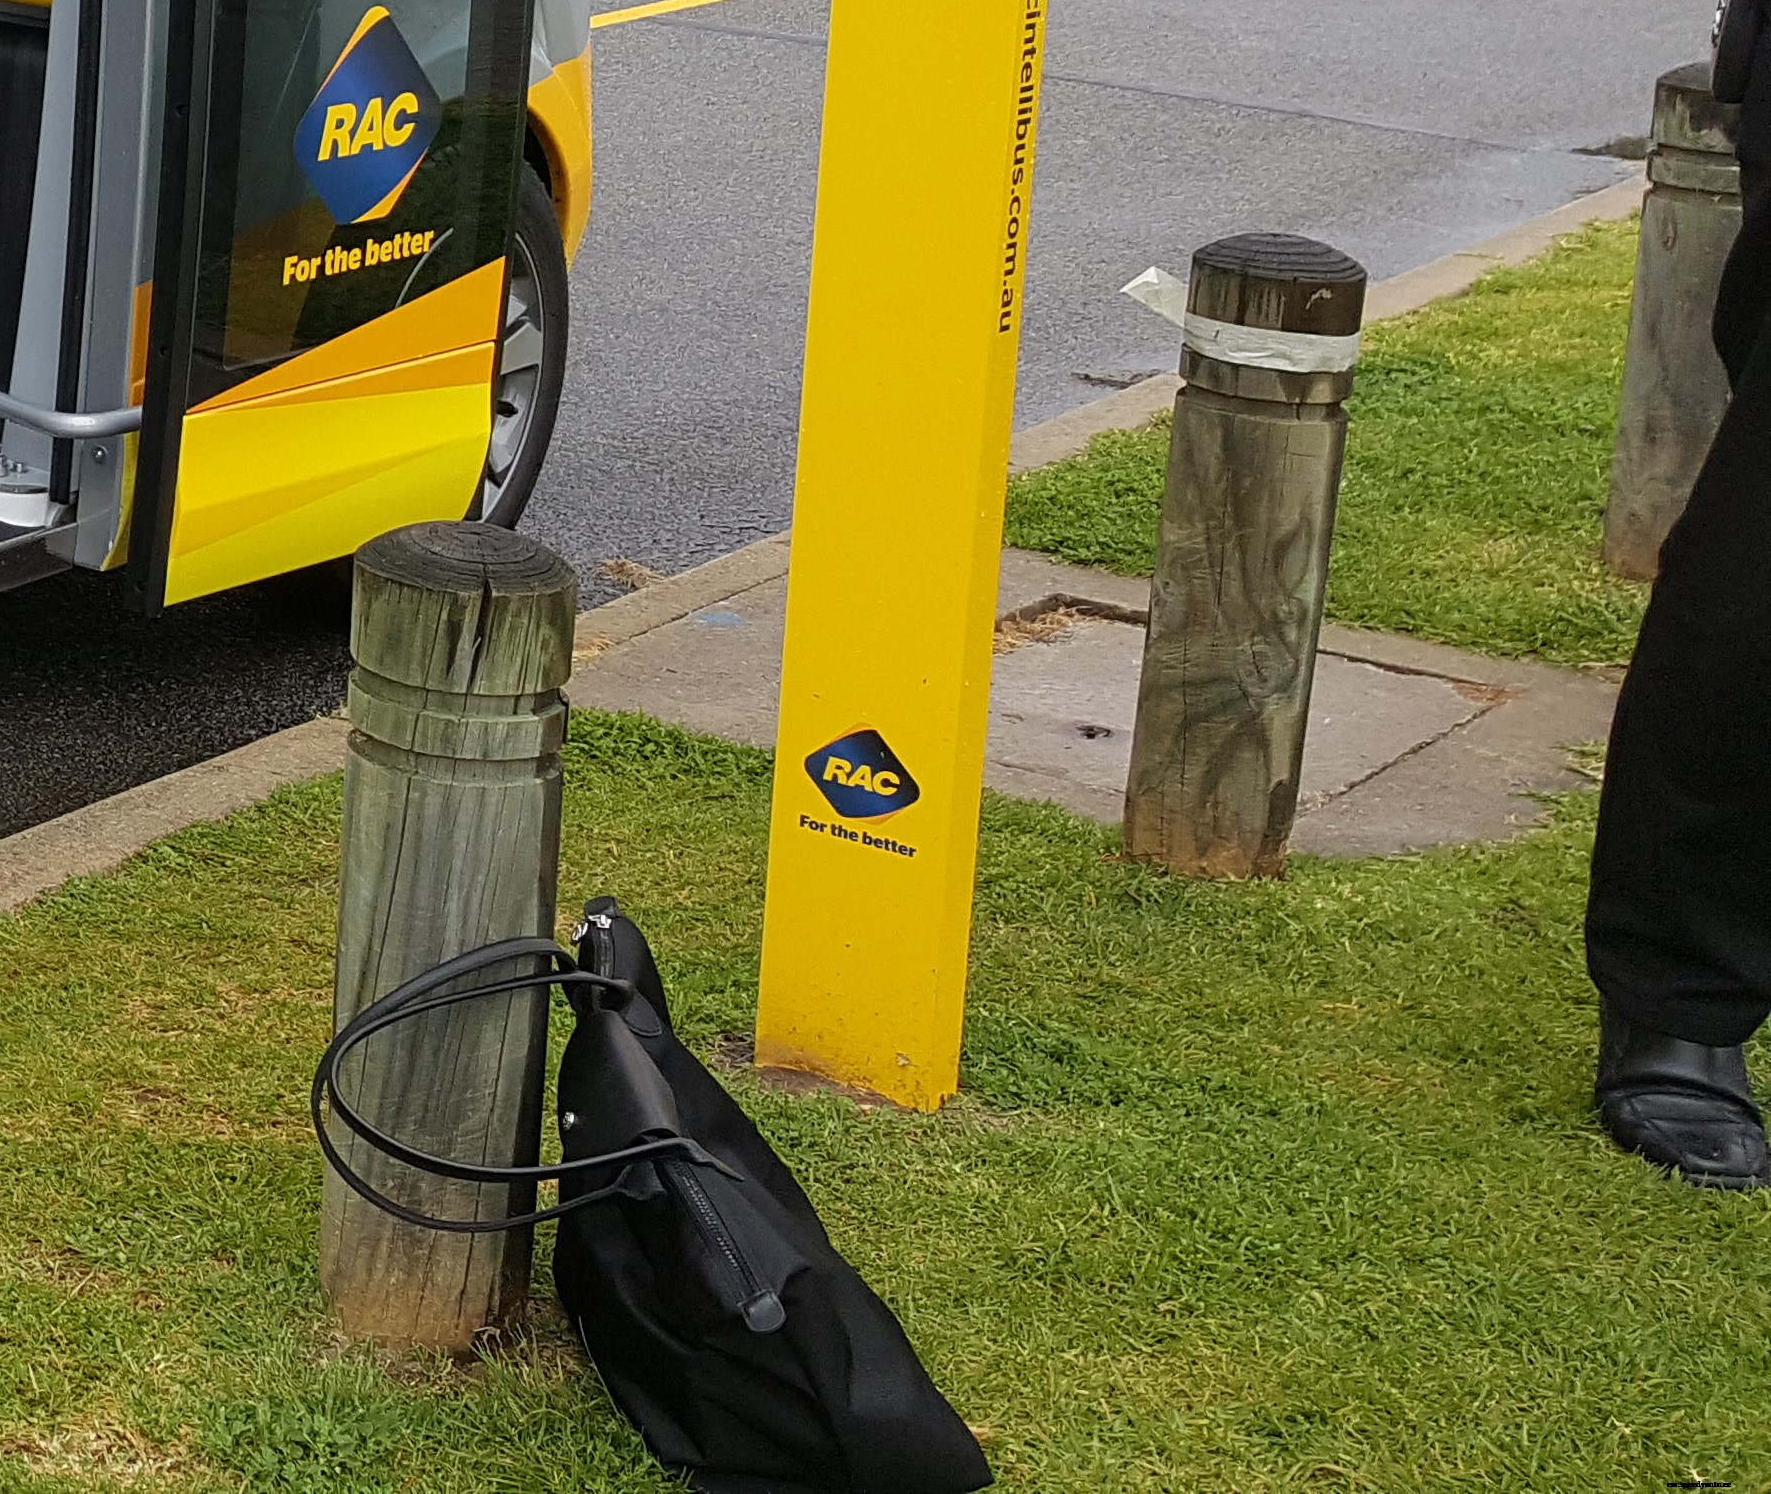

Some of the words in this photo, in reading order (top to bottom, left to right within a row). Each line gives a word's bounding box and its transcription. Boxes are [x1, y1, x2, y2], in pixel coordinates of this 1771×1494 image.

[317, 92, 420, 162] RAC
[282, 255, 321, 286] For
[325, 245, 362, 275] the
[365, 230, 435, 265] better
[822, 756, 901, 796] RAC
[799, 814, 827, 833] For
[831, 823, 859, 842] the
[861, 831, 917, 857] better
